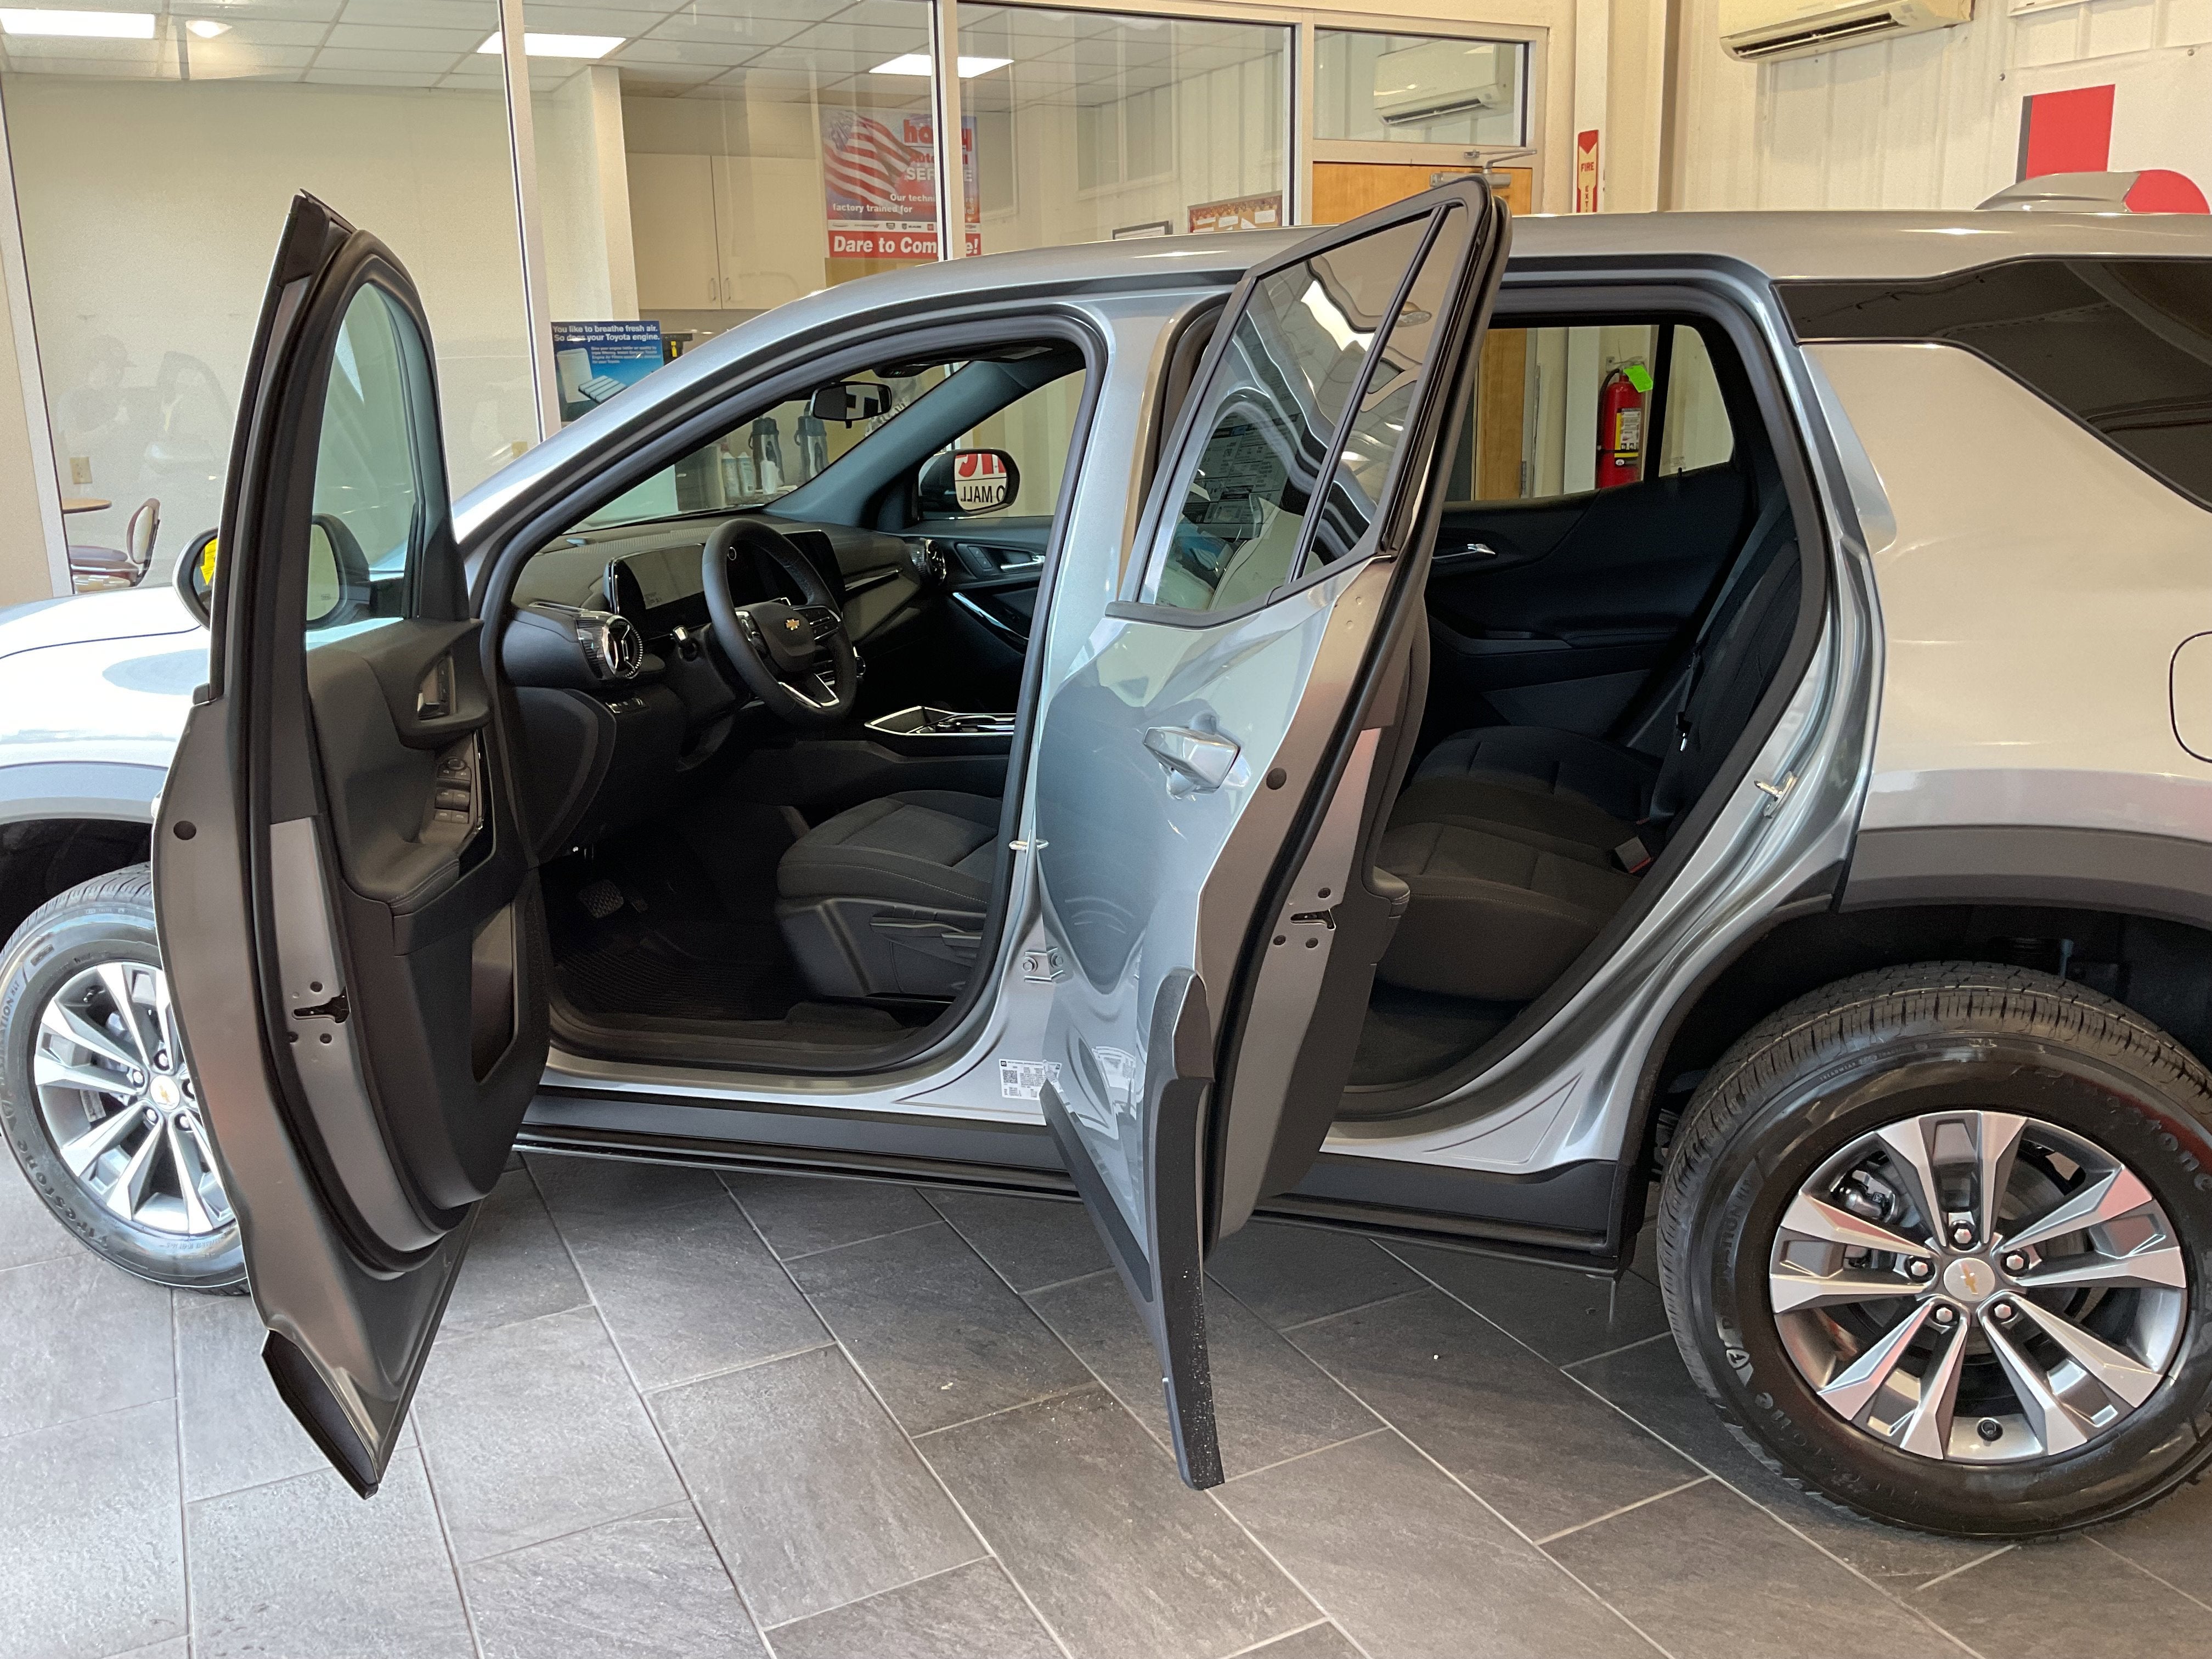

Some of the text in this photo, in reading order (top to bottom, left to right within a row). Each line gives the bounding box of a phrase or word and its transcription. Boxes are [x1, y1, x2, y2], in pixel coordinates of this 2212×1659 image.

[1581, 162, 1594, 172] FIRE
[832, 204, 913, 214] factory trained for
[833, 236, 873, 252] Dare
[879, 237, 895, 253] to
[594, 325, 624, 333] breathe
[625, 324, 645, 332] fresh
[605, 333, 631, 342] Toyota
[632, 334, 661, 342] engine.
[1819, 1062, 1856, 1081] TREADWEAR
[17, 1139, 109, 1251] Firestone
